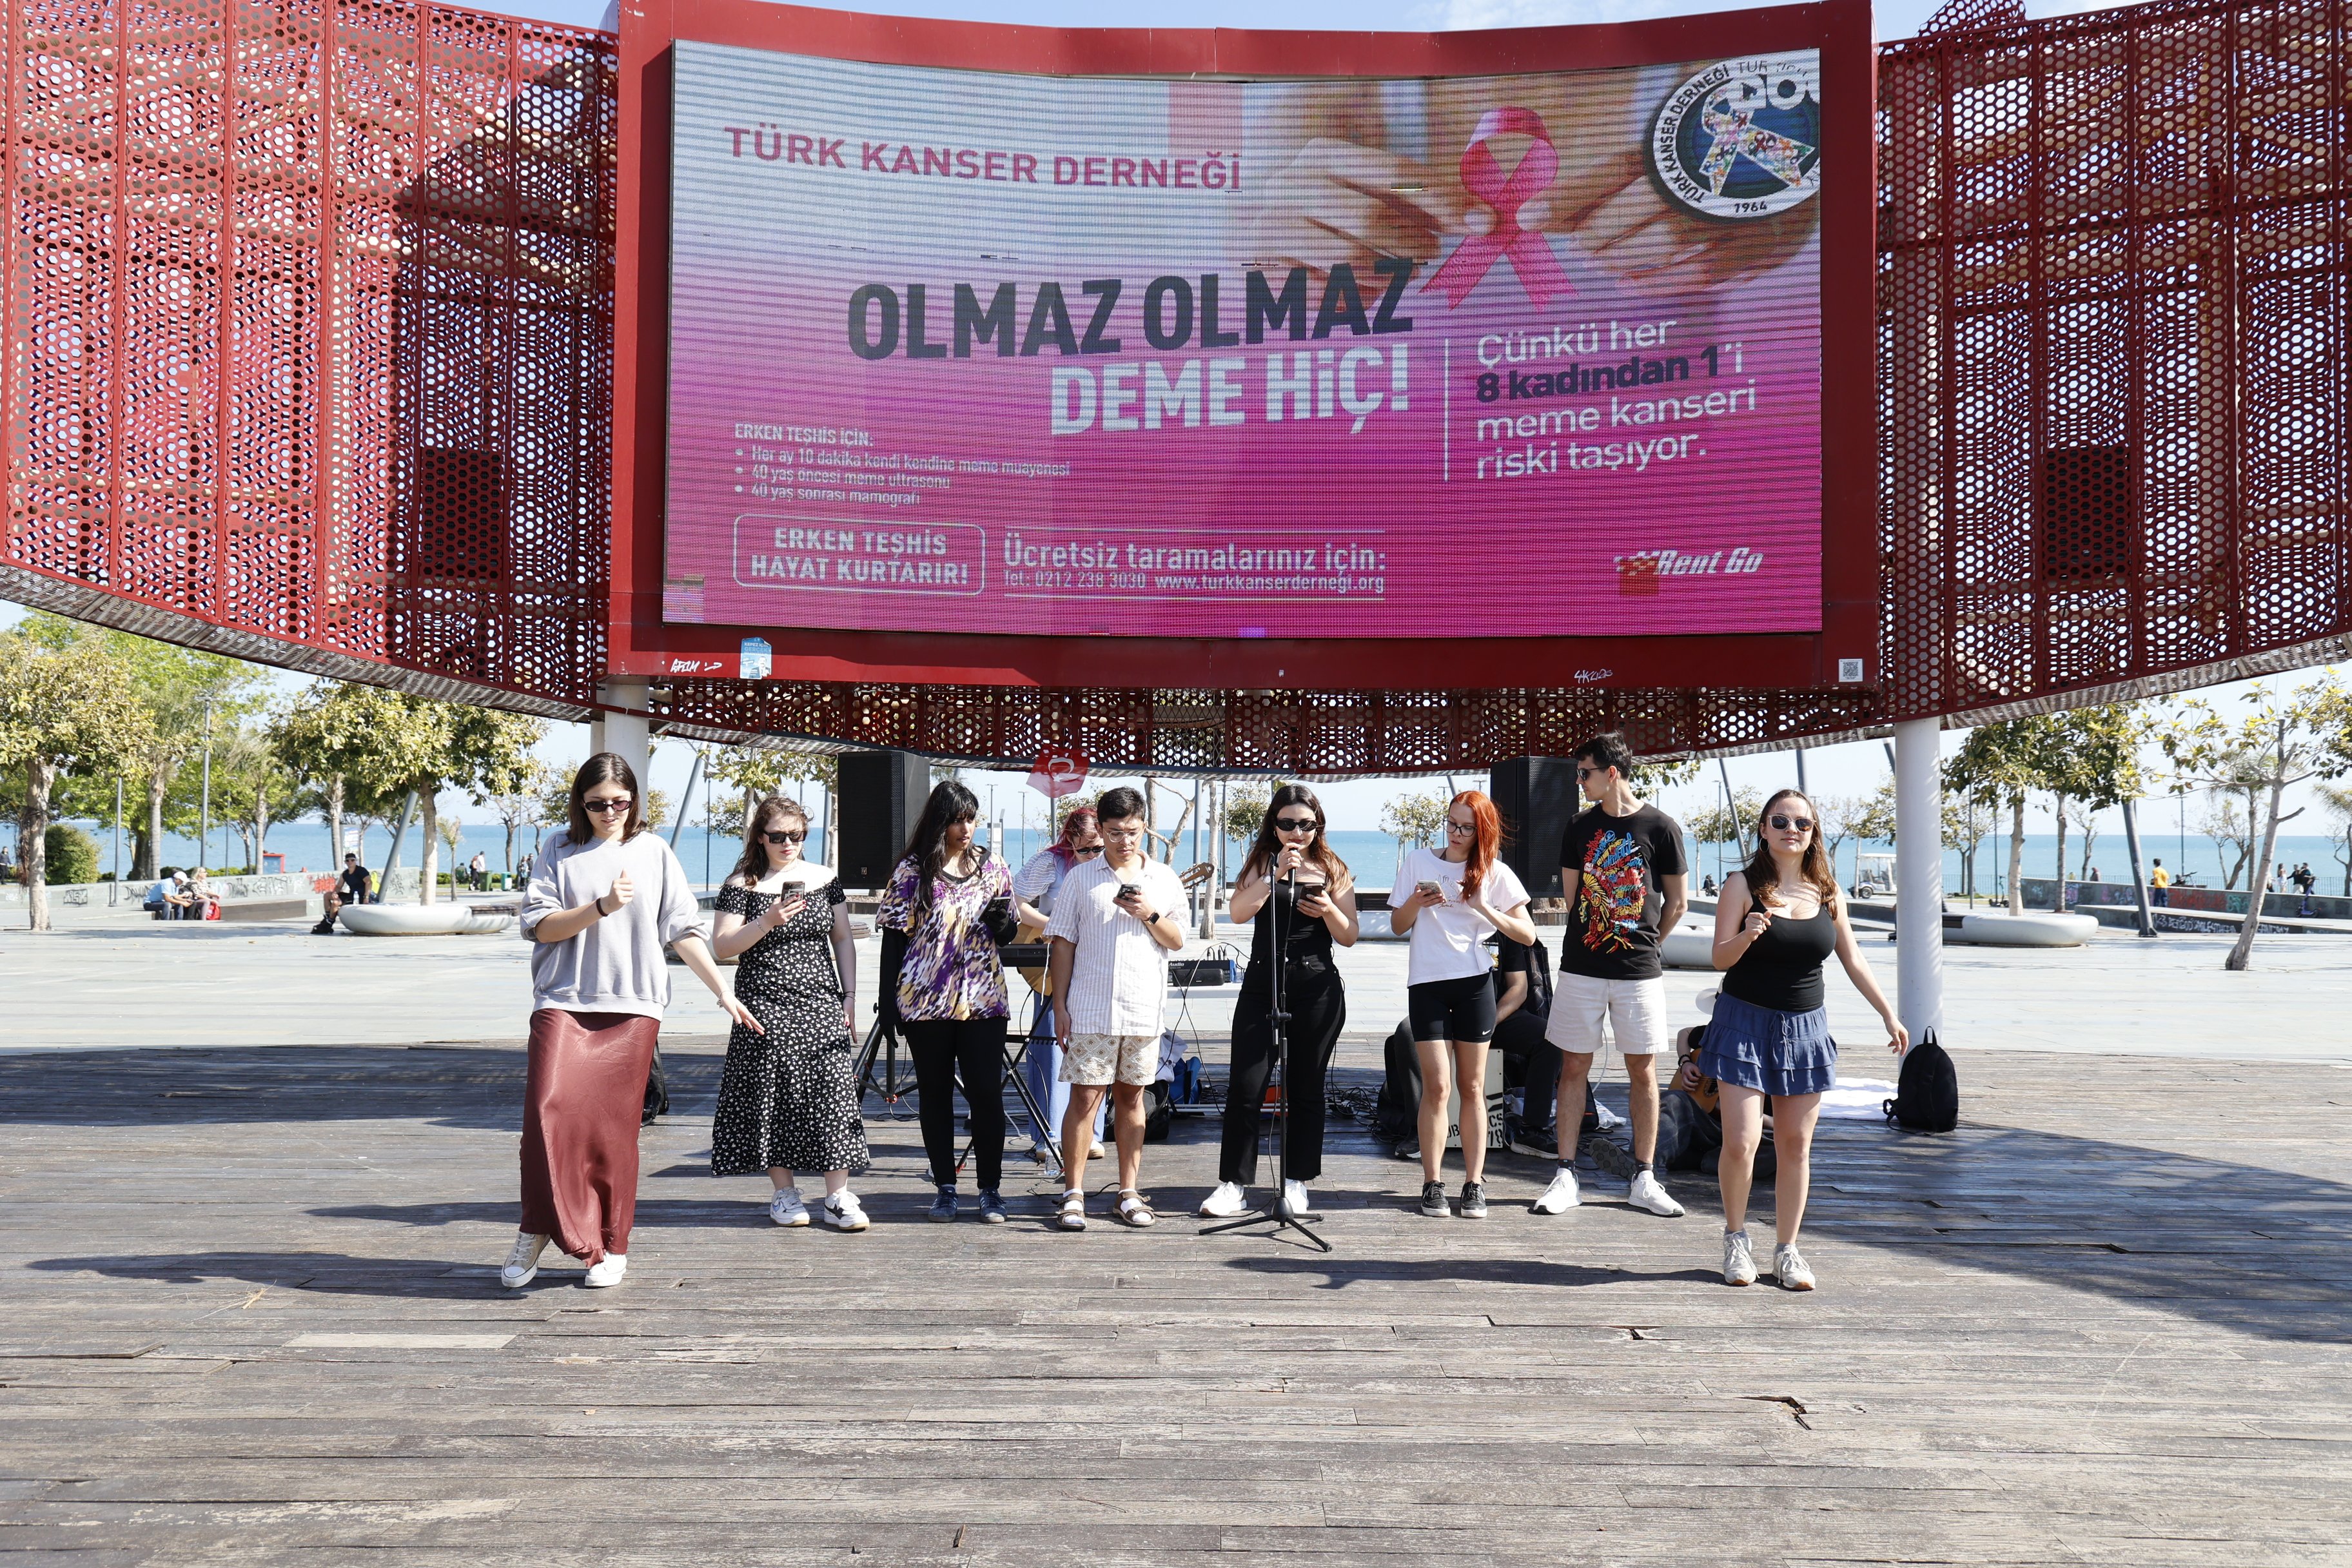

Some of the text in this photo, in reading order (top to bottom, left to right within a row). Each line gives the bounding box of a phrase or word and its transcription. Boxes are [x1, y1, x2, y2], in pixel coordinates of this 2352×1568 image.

[1660, 64, 1730, 204] TÜRK KANSER DERNEĞİ
[724, 122, 1240, 190] TÜRK KANSER DERNEĞİ
[1734, 201, 1768, 213] 1964
[847, 257, 1414, 360] OLMAZ OLMAZ
[1477, 319, 1678, 369] Çünkü her
[1051, 357, 1246, 436] DEME
[1476, 372, 1501, 404] 8
[1508, 356, 1690, 400] kadından
[1477, 378, 1756, 442] meme kanseri
[735, 423, 783, 441] ERKEN
[751, 445, 1070, 480] Her ay 10 dakika kendi kendine meme muayenesi
[752, 464, 950, 489] 40 yaş öncesi meme ultrasonu
[1477, 433, 1708, 480] riski taşıyor.
[752, 483, 768, 498] 40
[771, 486, 794, 502] yaş
[798, 487, 845, 502] sonrası
[774, 527, 948, 560] ERKEN TEŞHİS
[1003, 532, 1386, 578] Ücretsiz taramalarınız için:
[1654, 546, 1765, 576] Rent Go
[750, 554, 968, 585] HAYAT KURTARIR!
[1034, 570, 1073, 588] 0212
[1077, 571, 1104, 588] 238
[1109, 572, 1147, 589] 3030
